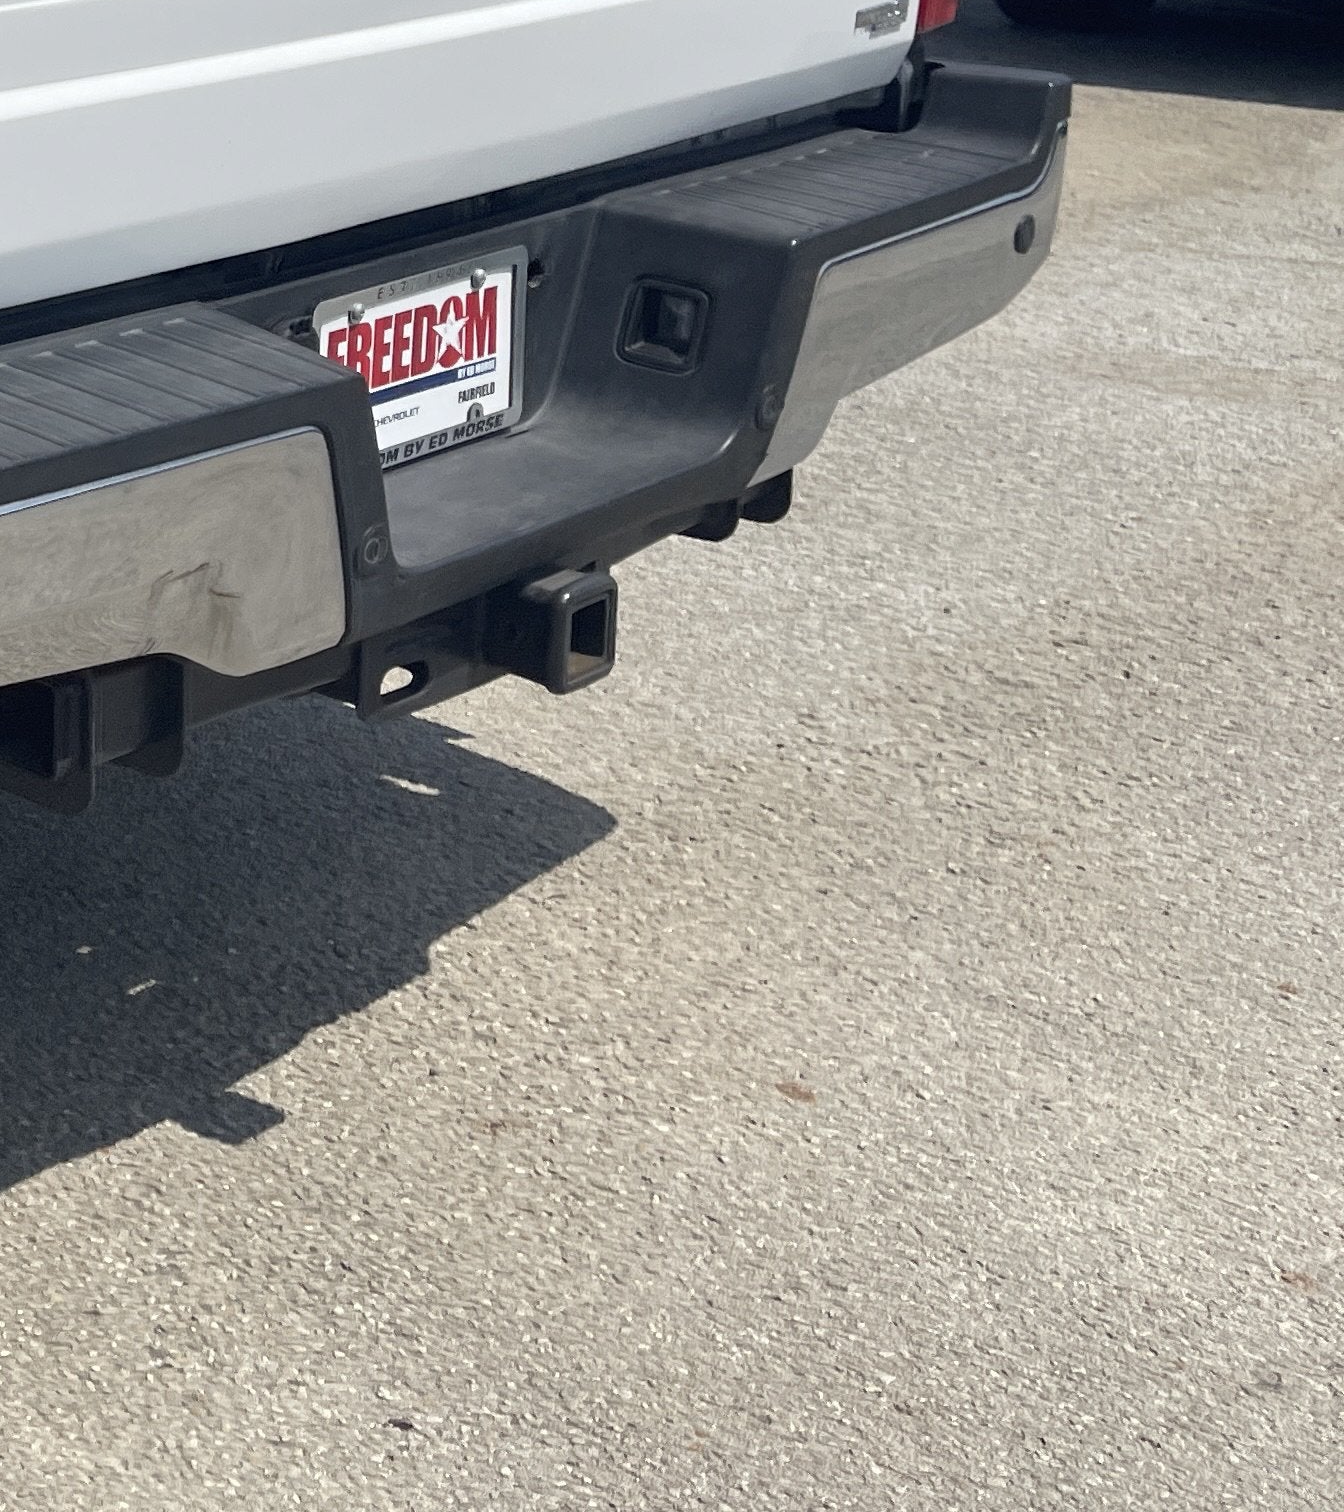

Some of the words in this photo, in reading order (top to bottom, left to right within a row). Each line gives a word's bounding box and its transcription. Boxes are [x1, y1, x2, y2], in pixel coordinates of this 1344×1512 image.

[458, 381, 496, 404] FAIRFIELD
[403, 439, 425, 458] BY
[428, 432, 448, 450] ED
[453, 414, 504, 441] MORSE
